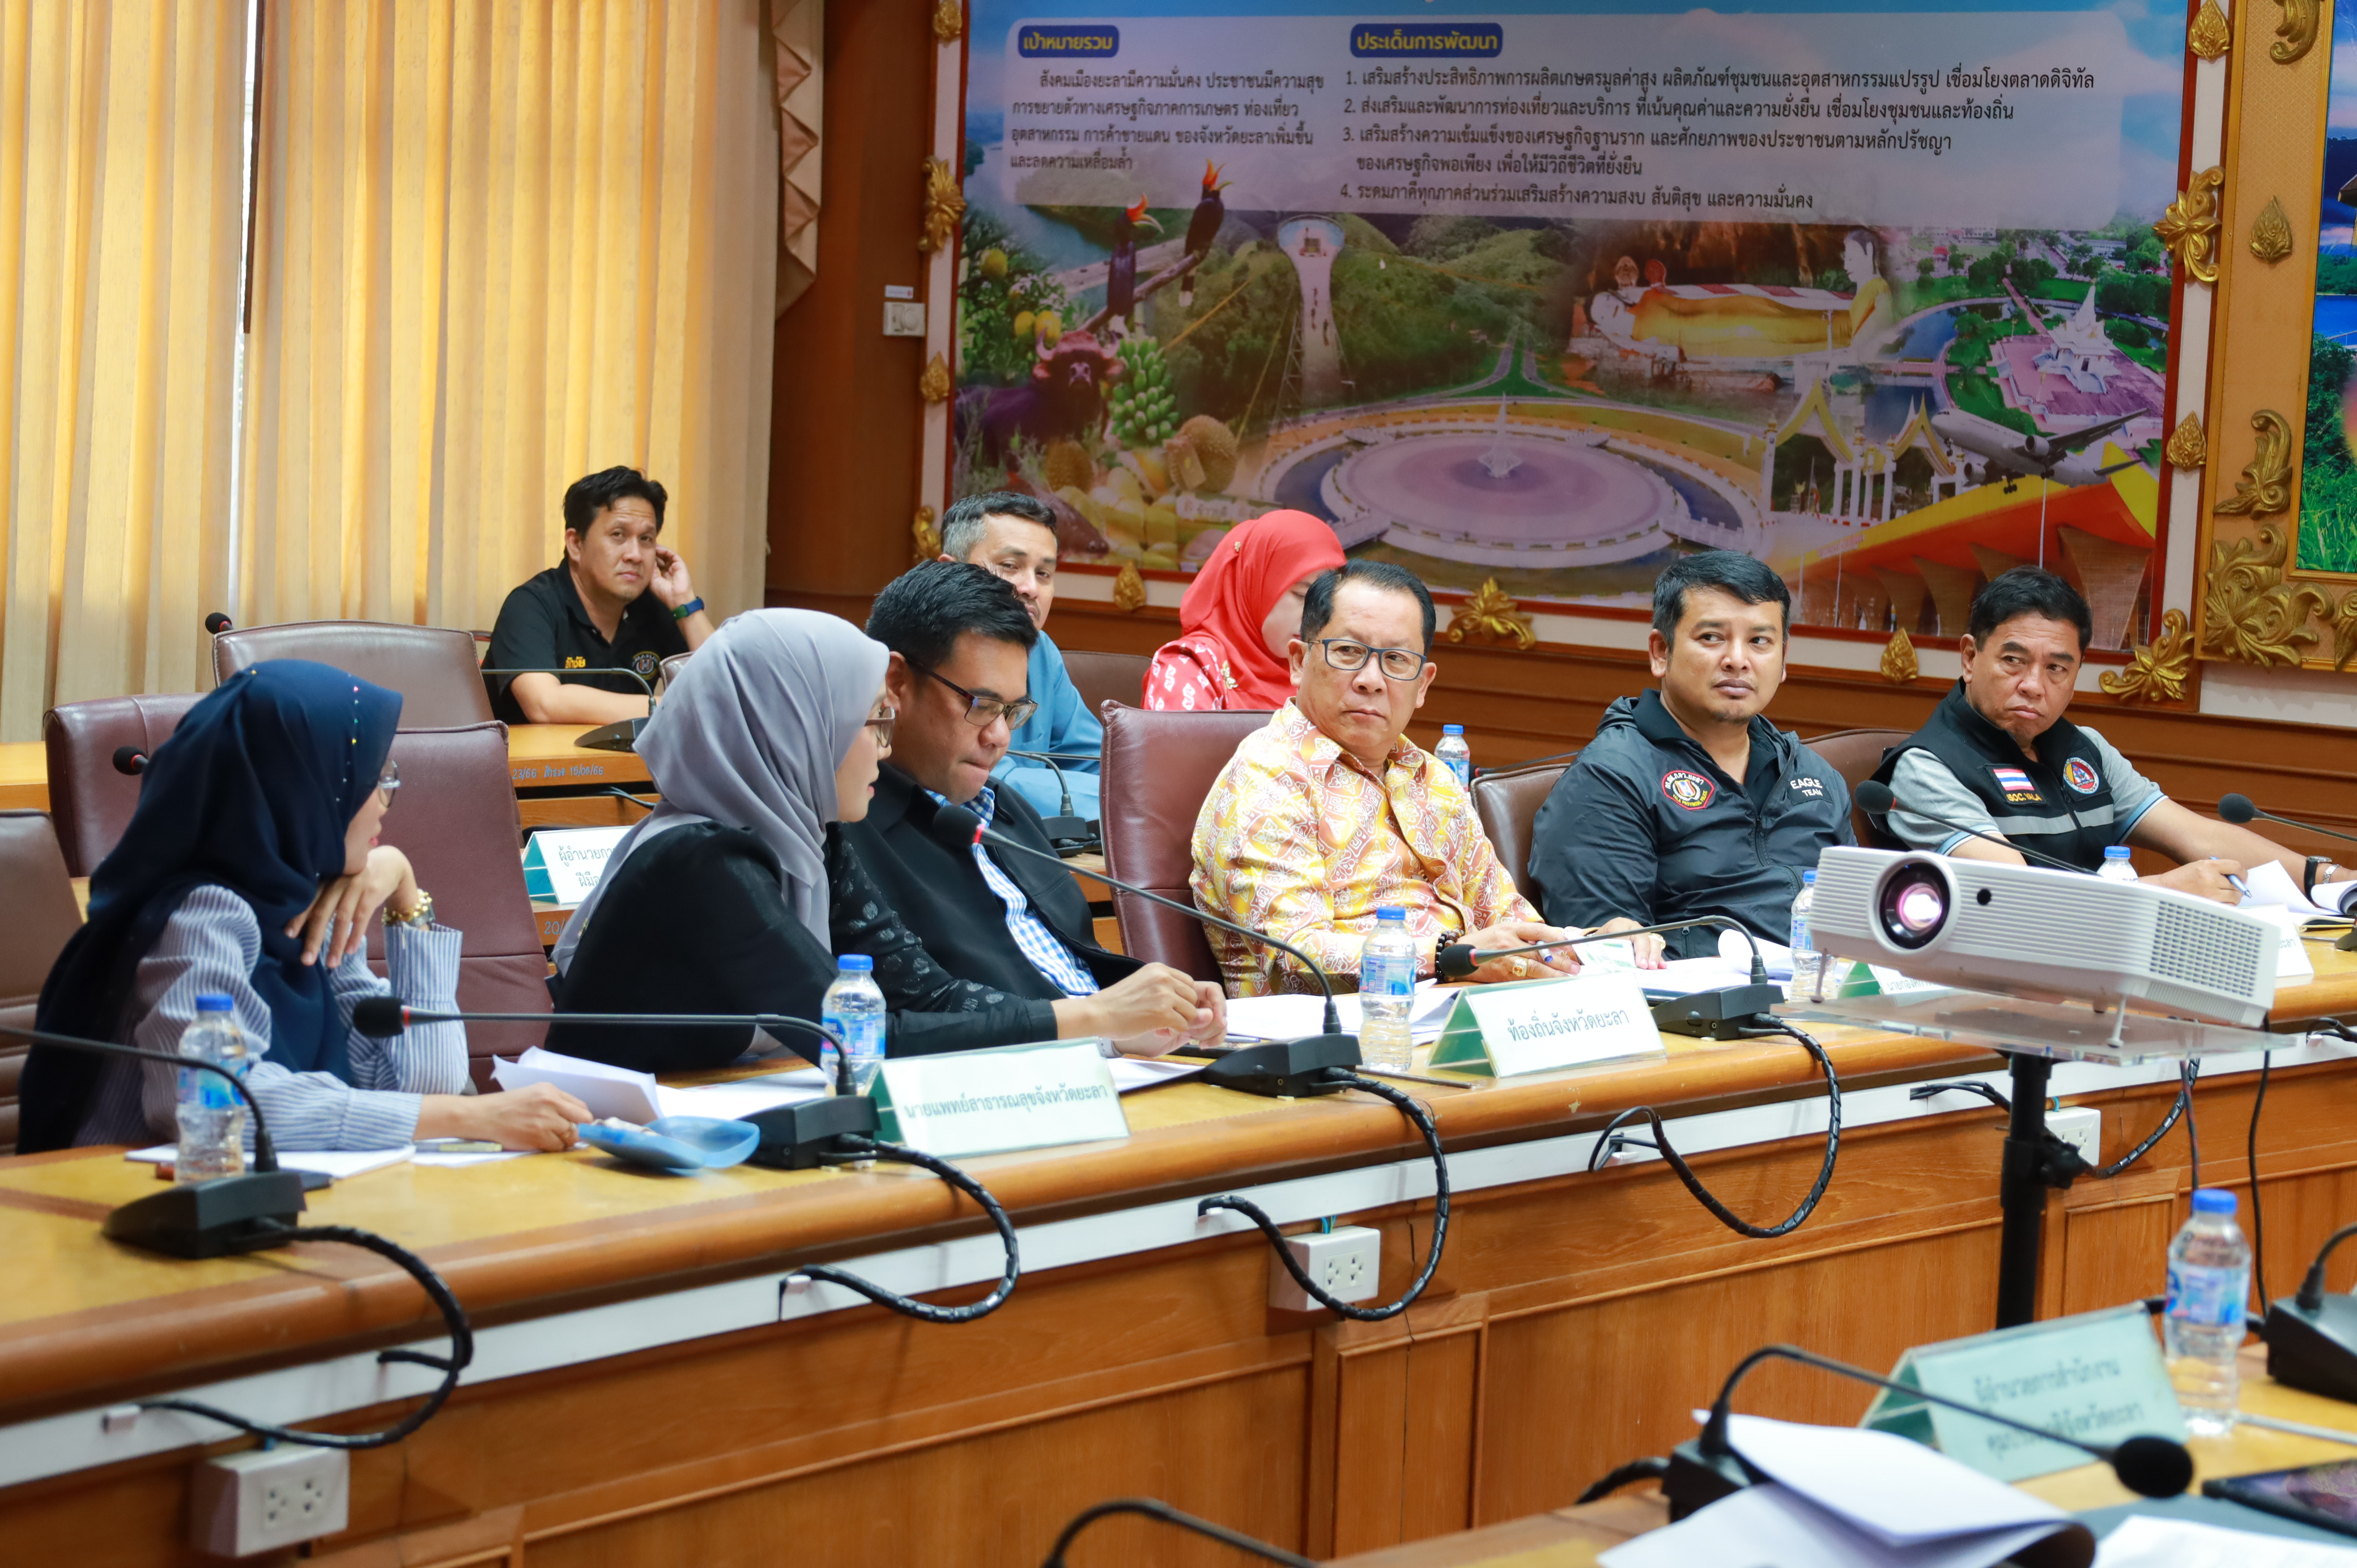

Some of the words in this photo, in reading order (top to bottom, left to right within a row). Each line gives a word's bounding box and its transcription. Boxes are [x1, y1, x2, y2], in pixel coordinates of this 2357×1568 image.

[1023, 31, 1113, 50] เป้าหมายรวม
[1357, 29, 1498, 50] ประเด็นการพัฒนา
[1205, 70, 1325, 95] ประชาชนมีความสุข
[1346, 70, 1357, 86] 1.
[1362, 65, 1657, 93] เสริมสร้างประสิทธิภาพการผลิตเกษตรมูลค่าสูง
[1662, 66, 1939, 95] ผลิตภัณฑ์ชุมชนและอุตสาหกรรมแปรรูป
[1946, 62, 2094, 89] เชื่อมโยงตลาดดิจิทัล
[1244, 93, 1299, 117] ท่องเที่ยว
[1345, 98, 1356, 113] 2.
[1361, 91, 1630, 116] ส่งเสริมและพัฒนาการท่องเที่ยวและบริการ
[1636, 92, 1820, 123] ที่เน้นคุณค่าและความยั่งยืน
[1827, 93, 2014, 125] เชื่อมโยงชุมชนและท้องถิ่น
[1011, 128, 1079, 146] อุตสาหกรรม
[1175, 120, 1314, 145] ของจังหวัดยะลาเพิ่มขึ้น
[1343, 127, 1355, 142] 3.
[1360, 122, 1644, 151] เสริมสร้างความเข้มแข็งของเศรษฐกิจฐานราก
[1651, 126, 1951, 156] และศักยภาพของประชาชนตามหลักปรัชญา
[1010, 146, 1133, 169] และลดความเหลื่อมล้ำ
[1357, 152, 1491, 177] ของเศรษฐกิจพอเพียง
[1496, 150, 1643, 176] เพื่อให้มีวิถีชีวิตที่ยั่งยืน
[1340, 184, 1352, 198] 4.
[1651, 185, 1702, 213] สันติสุข
[1707, 184, 1813, 209] และความมั่นคง
[1790, 778, 1823, 789] EAGLE
[2006, 793, 2026, 802] ISOC.
[2024, 793, 2043, 802] YALA
[1507, 1008, 1630, 1043] ท้องถิ่นจังหวัดยะลา
[904, 1082, 1108, 1119] นายแพทย์สาธารณสุขจังหวัดยะลา
